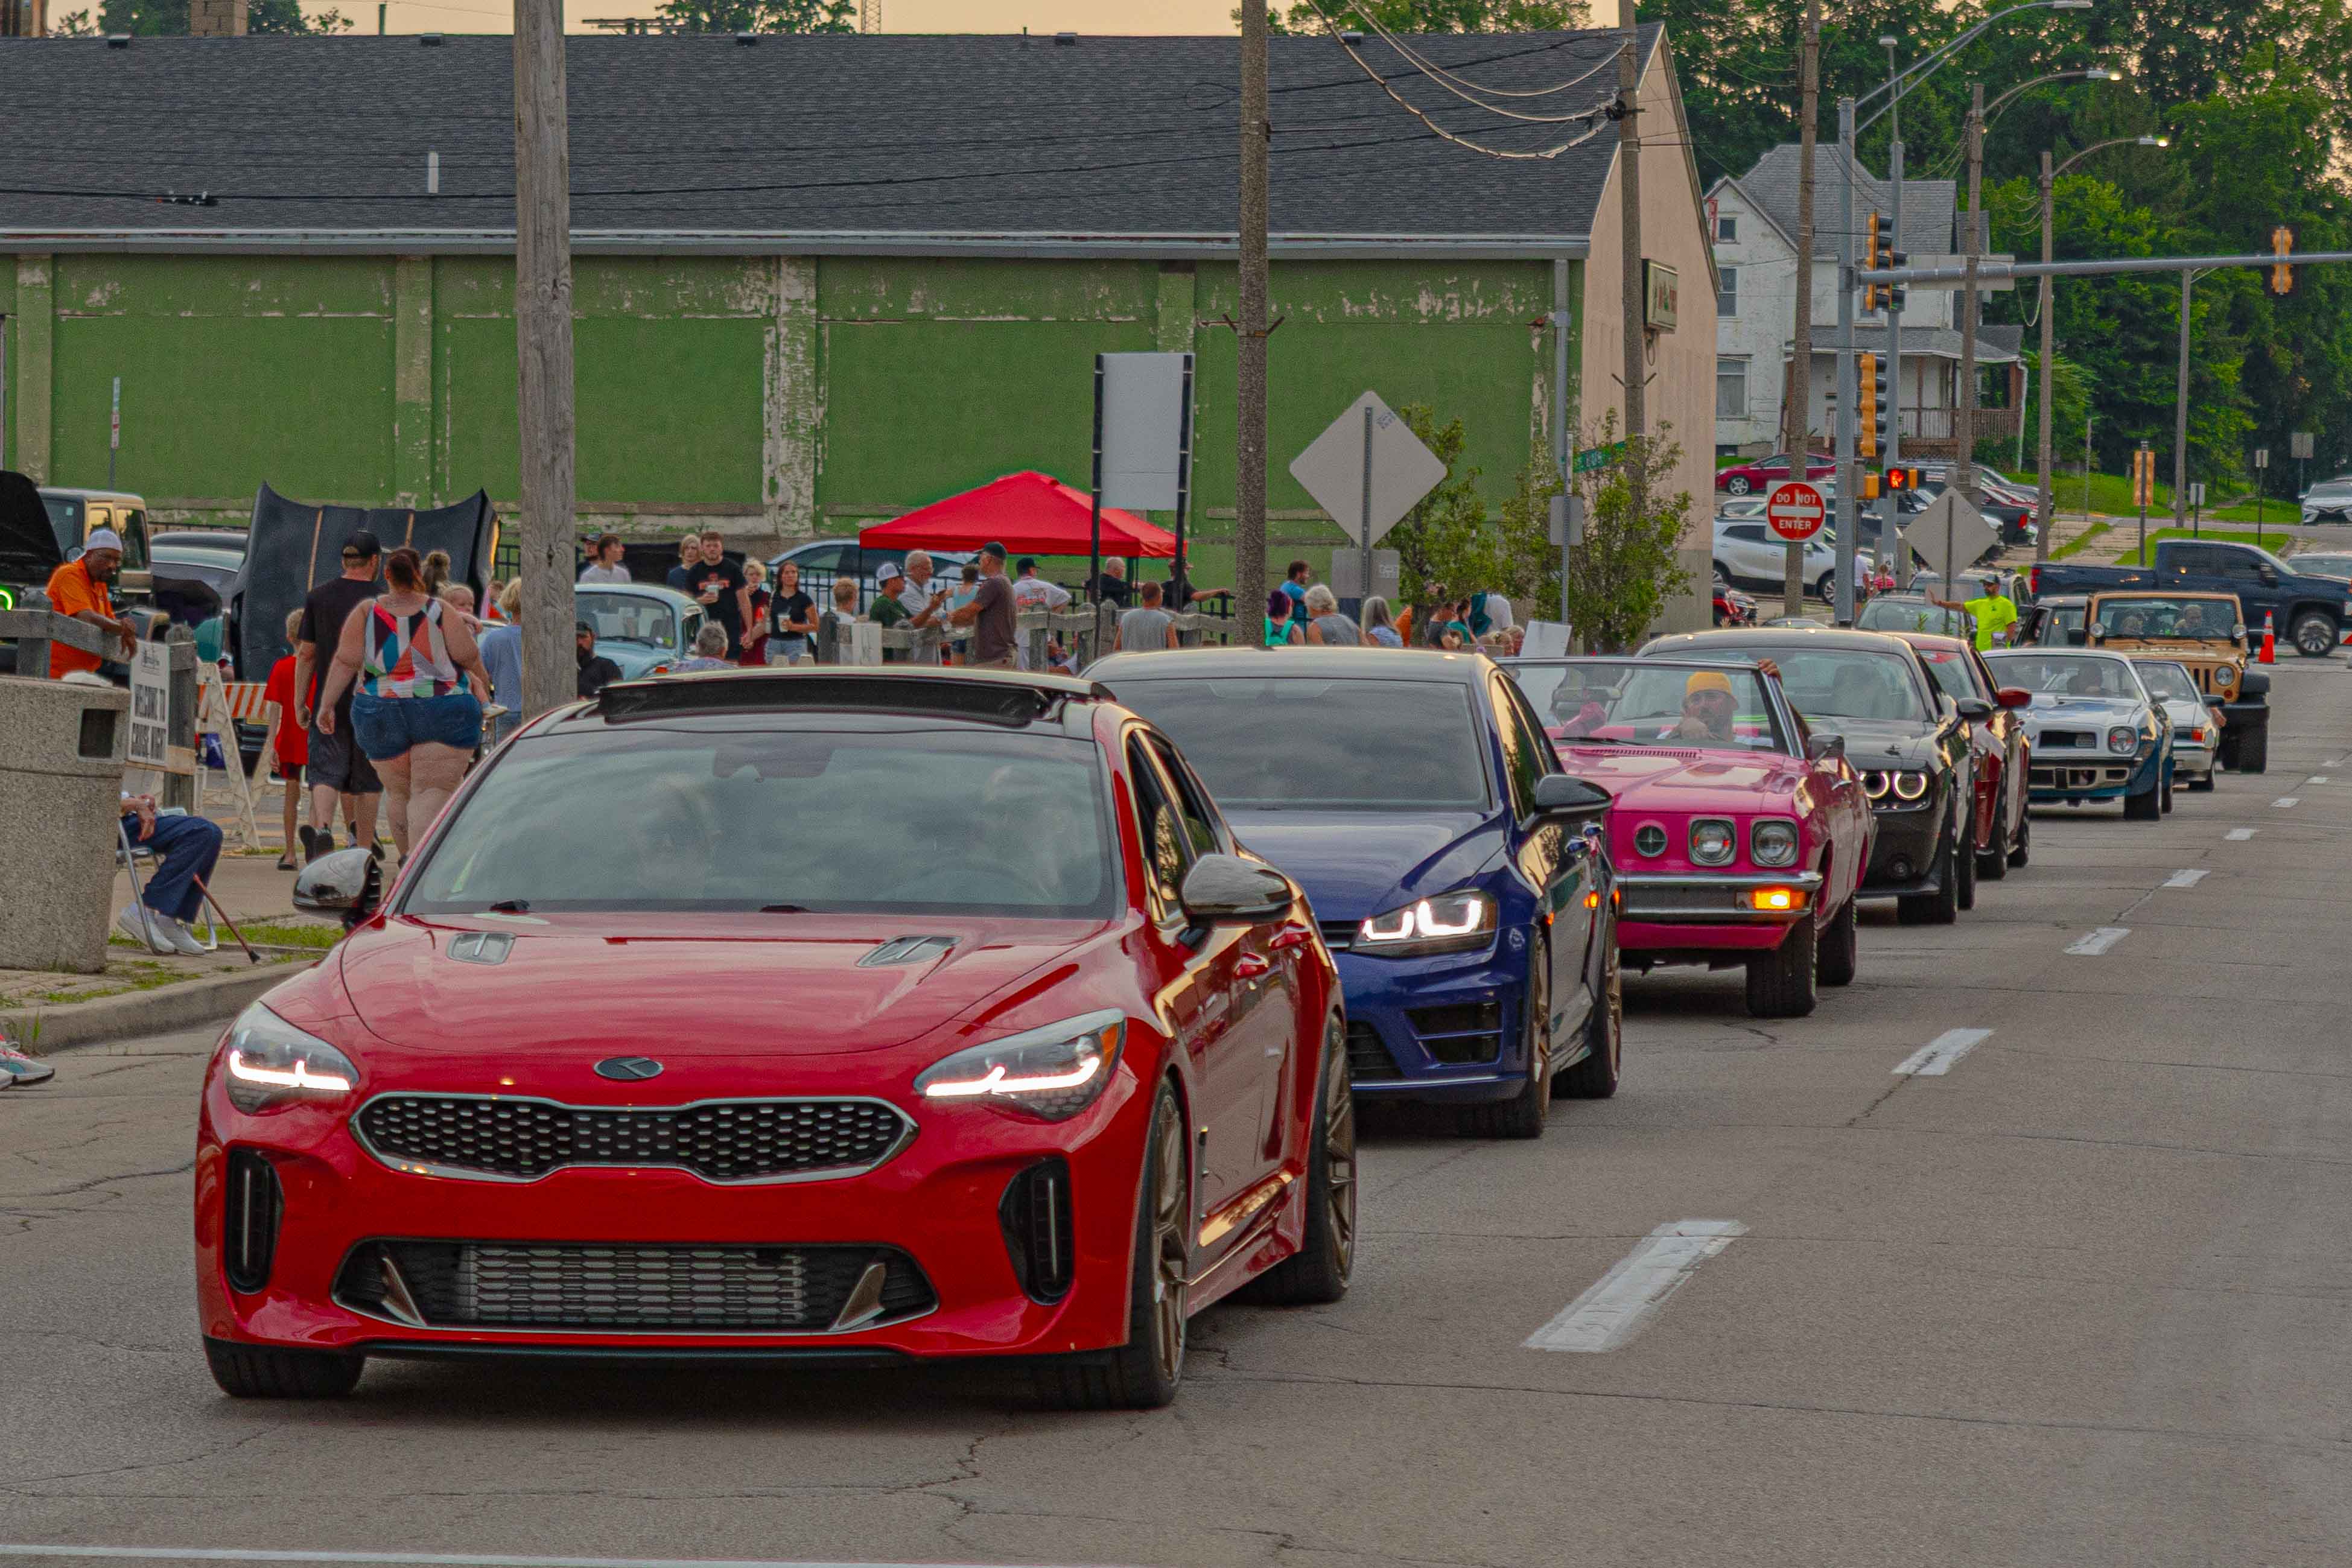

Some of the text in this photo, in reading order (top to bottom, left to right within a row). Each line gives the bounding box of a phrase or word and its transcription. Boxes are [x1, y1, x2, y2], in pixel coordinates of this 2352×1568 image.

[1776, 494, 1817, 504] DO NOT
[1779, 520, 1812, 530] ENTER
